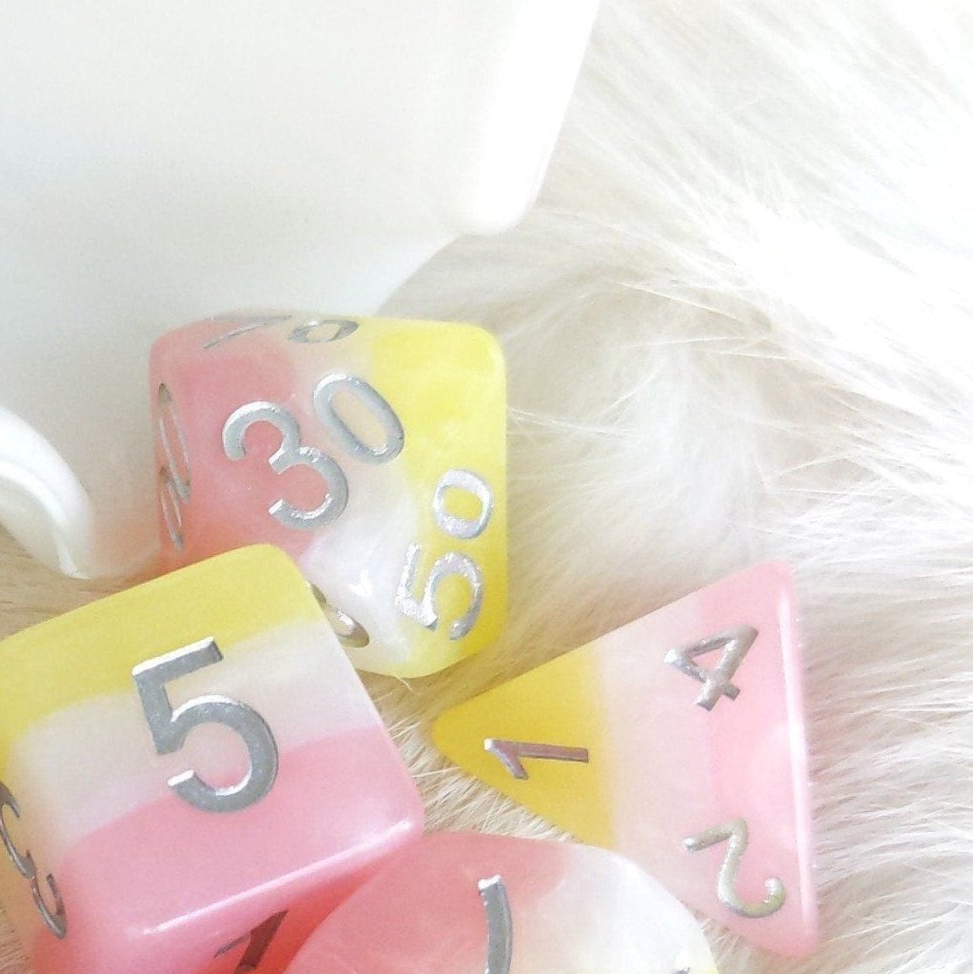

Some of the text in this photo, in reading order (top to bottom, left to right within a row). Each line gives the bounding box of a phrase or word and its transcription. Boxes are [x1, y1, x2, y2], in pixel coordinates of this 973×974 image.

[221, 372, 406, 530] 30
[394, 467, 494, 642] 50
[131, 636, 279, 814] 5
[663, 624, 759, 711] 4
[484, 737, 590, 780] 1
[682, 818, 787, 919] 2
